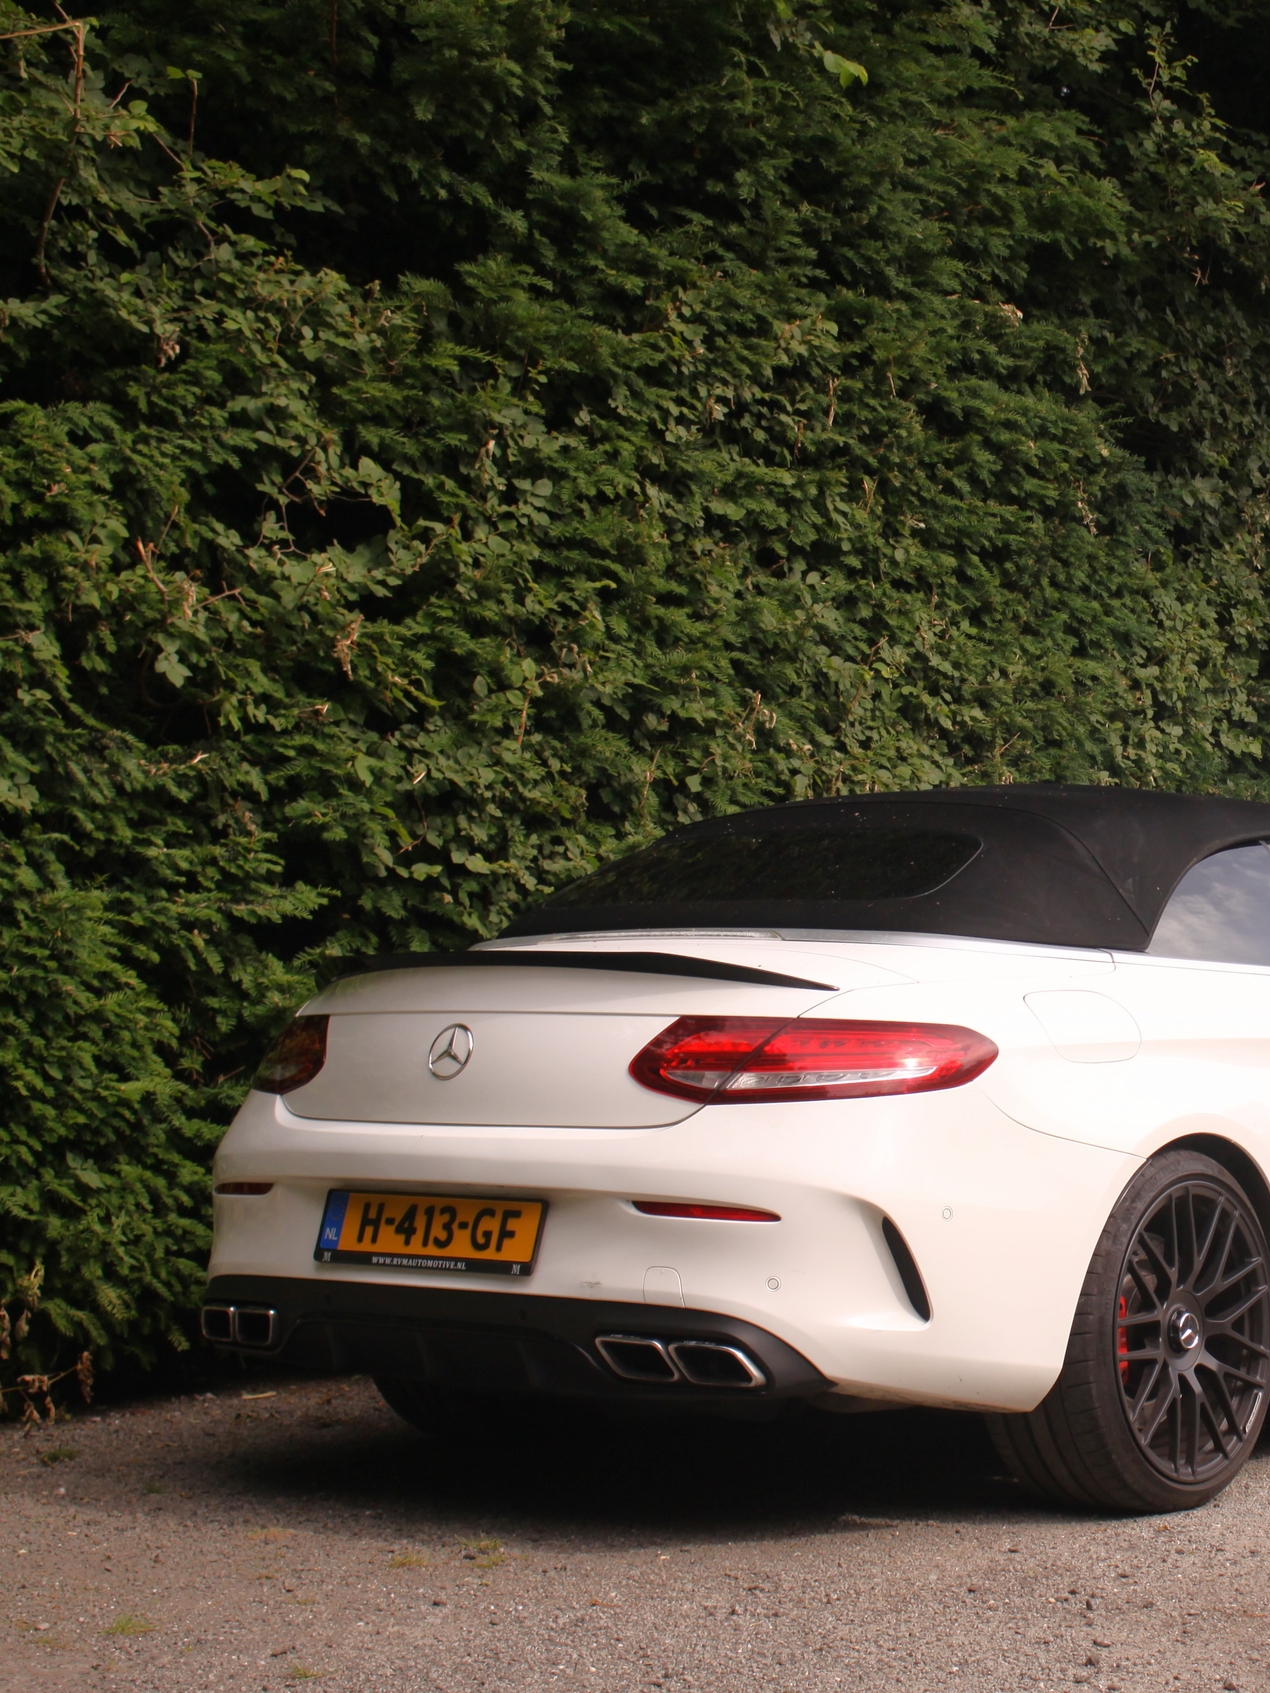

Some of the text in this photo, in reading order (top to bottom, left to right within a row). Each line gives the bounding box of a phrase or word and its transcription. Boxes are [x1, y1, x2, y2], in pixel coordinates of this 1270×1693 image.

[324, 1227, 338, 1241] NL
[356, 1201, 522, 1253] H-413-GF
[371, 1255, 467, 1271] WWW.RVMAUTOMOTIVE.NL
